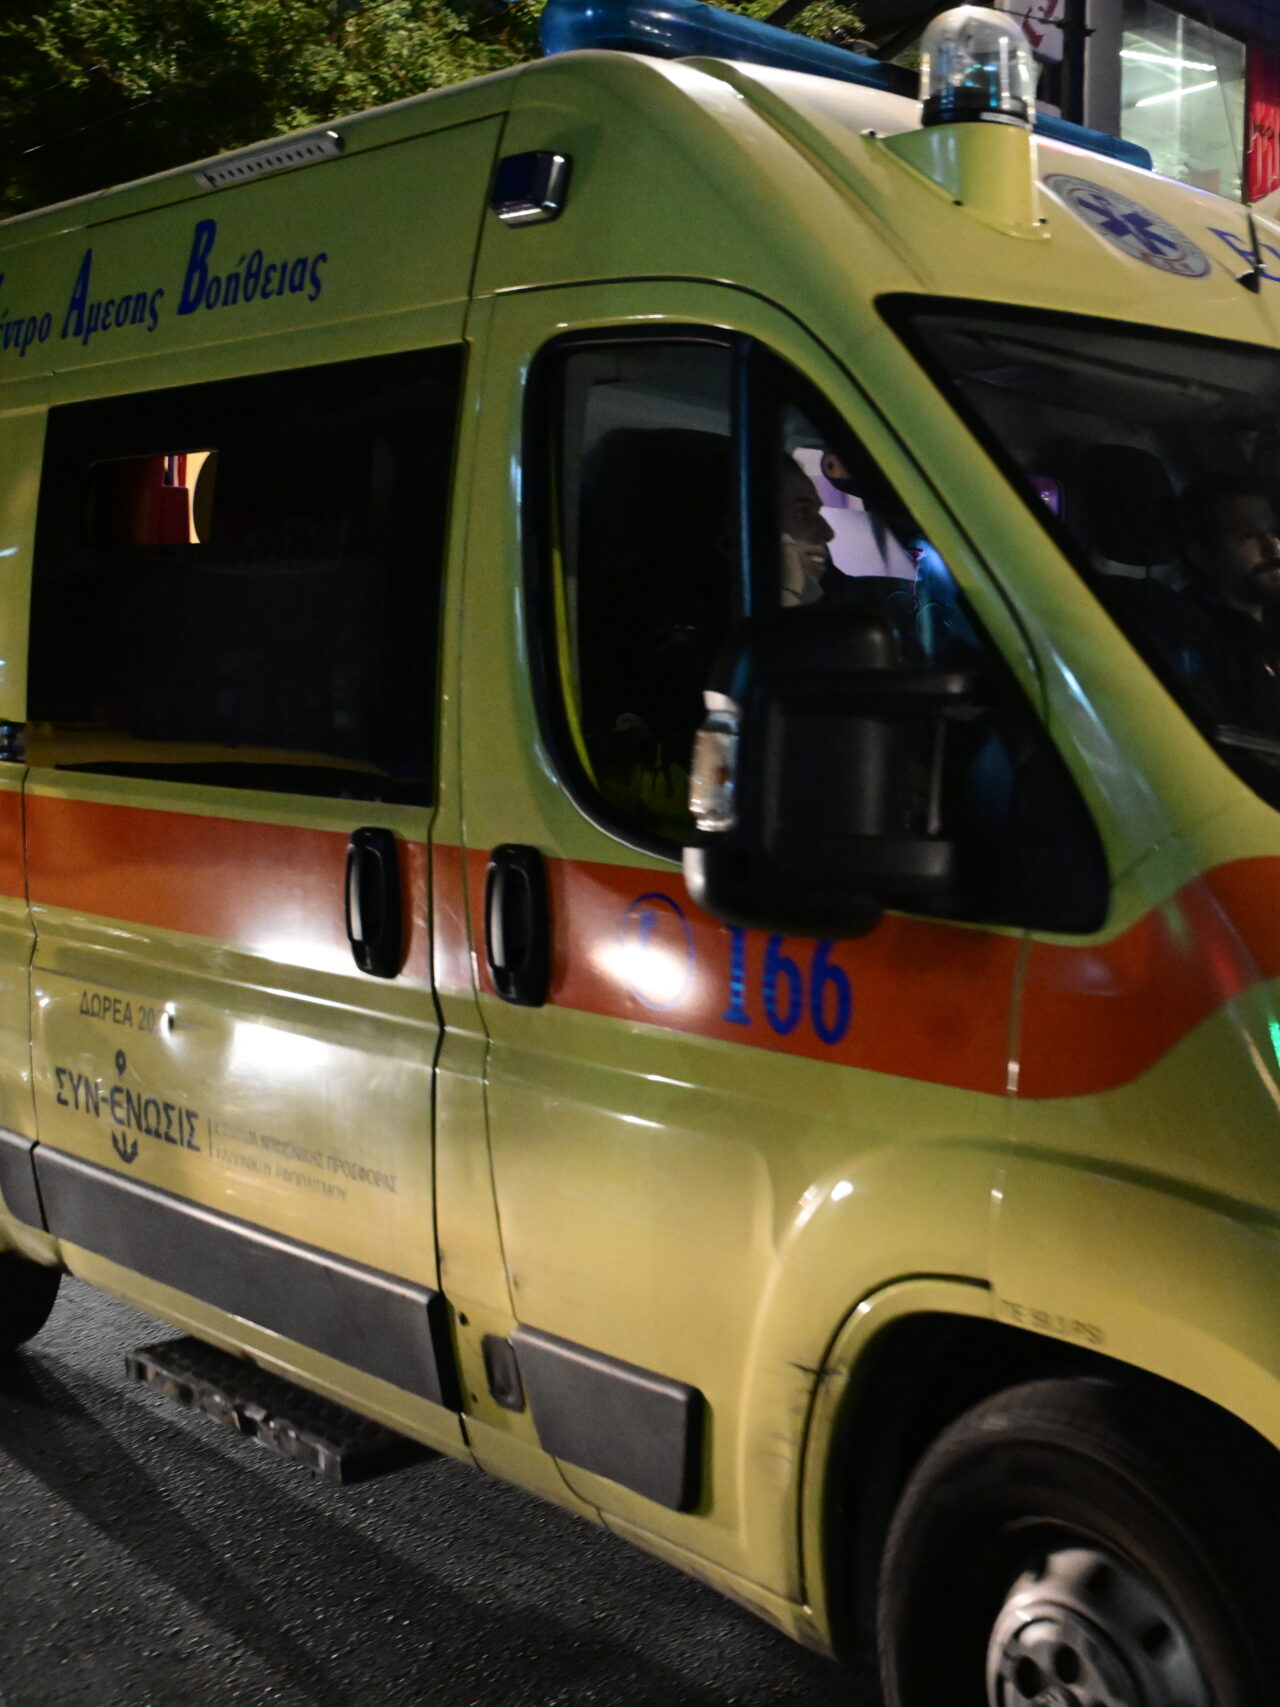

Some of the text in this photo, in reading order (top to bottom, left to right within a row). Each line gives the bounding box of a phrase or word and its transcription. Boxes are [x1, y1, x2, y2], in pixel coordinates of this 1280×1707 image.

[60, 248, 164, 346] Αμεσης
[177, 218, 328, 316] Βοήθειας
[79, 990, 133, 1029] ΔΩΡΕΑ
[722, 924, 852, 1044] 166
[55, 1065, 201, 1152] ΣΥΝ-ΕΝΩΣΙΣ
